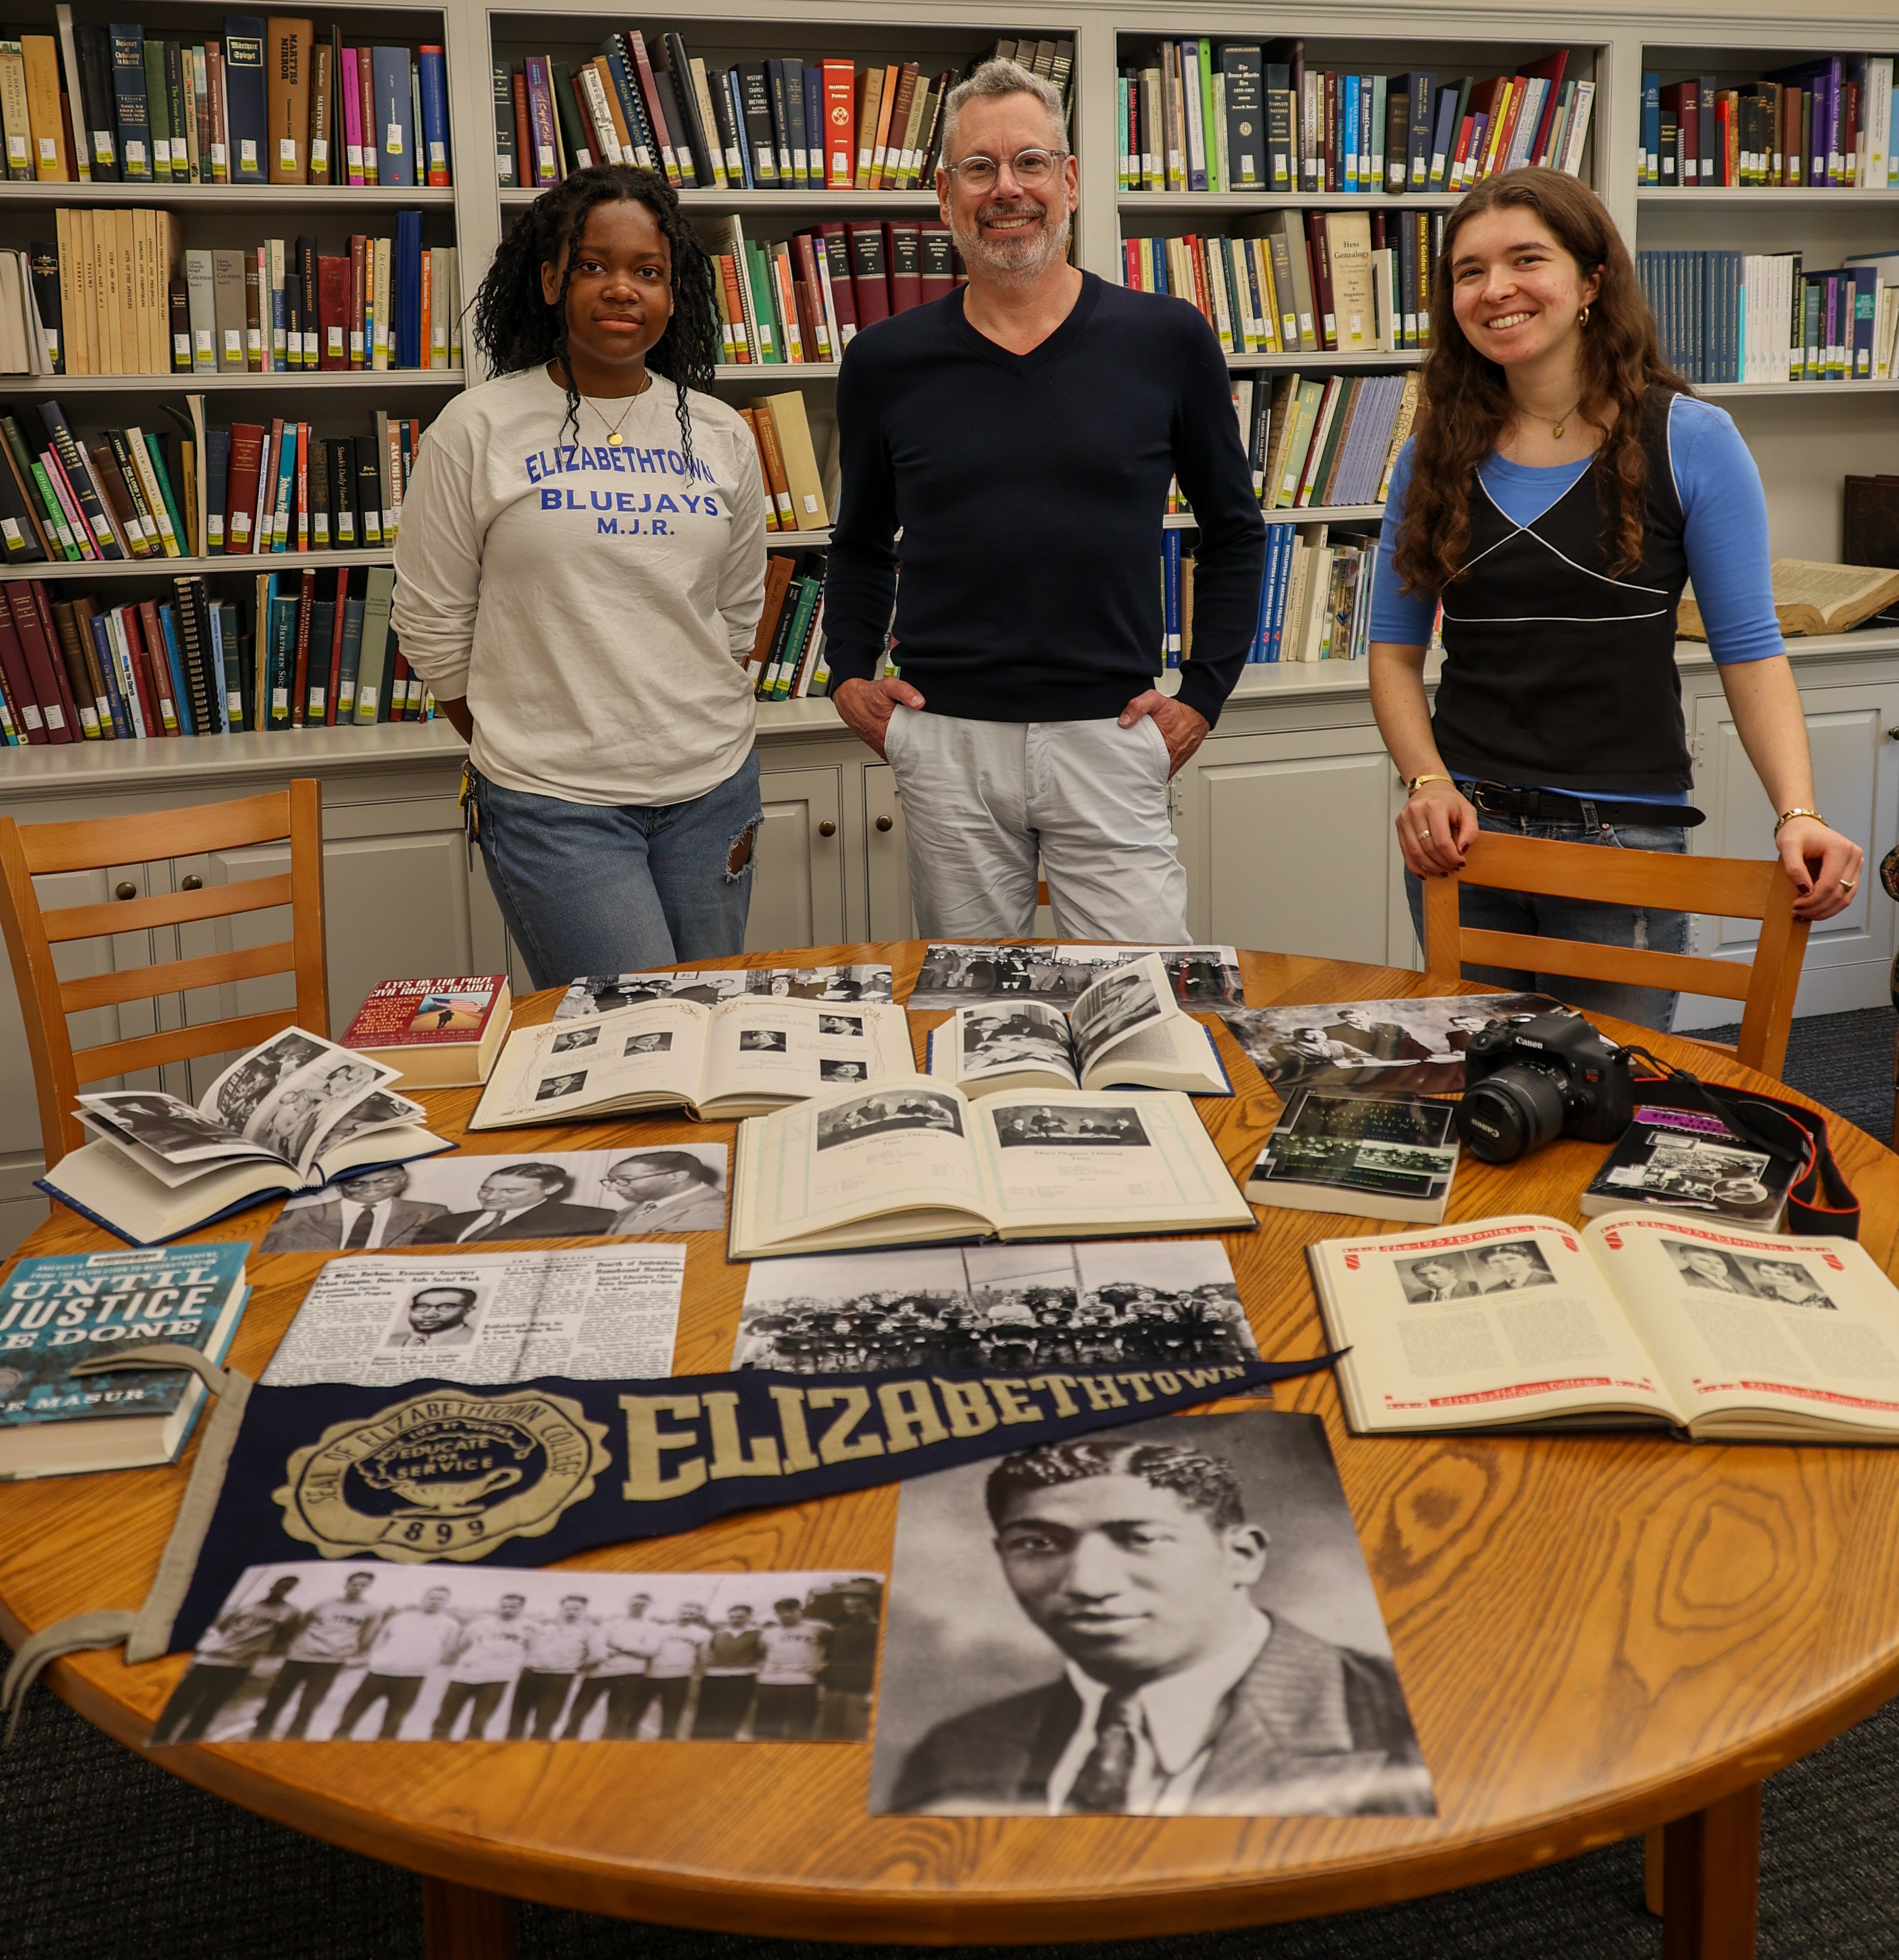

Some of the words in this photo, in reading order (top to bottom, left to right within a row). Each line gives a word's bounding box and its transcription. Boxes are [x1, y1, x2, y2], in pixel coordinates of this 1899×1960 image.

[289, 33, 298, 85] MARTYRS
[6, 66, 15, 118] REFORMATION
[619, 80, 627, 99] FROM
[625, 102, 636, 122] THESE
[632, 124, 642, 145] ROOT
[1523, 95, 1533, 117] LIVING
[1576, 110, 1585, 129] Christ
[1515, 133, 1524, 149] LOVE
[378, 253, 385, 263] De
[275, 290, 283, 329] Postliberals
[1404, 384, 1417, 410] OUR
[1394, 411, 1411, 458] PRESENT
[113, 439, 125, 462] STOFFER
[129, 477, 141, 498] LORD'S
[136, 496, 148, 517] SUPPER
[525, 444, 720, 486] ELIZABETHTOWN
[540, 488, 718, 516] BLUEJAYS
[598, 517, 675, 535] M.J.R.
[1271, 546, 1279, 577] ENCYCLOPEDIA
[1283, 545, 1291, 576] ENCYCLOPEDIA
[1263, 631, 1270, 643] 3
[1274, 630, 1280, 641] 4
[369, 989, 396, 997] CIVIL
[400, 986, 444, 995] RIGHTS
[448, 983, 493, 992] READER
[385, 980, 413, 989] EYES
[1515, 1035, 1543, 1049] Canon
[1471, 1118, 1500, 1137] Canon
[11, 1267, 219, 1300] UNTIL
[0, 1286, 213, 1331] JUSTICE
[0, 1332, 40, 1351] E
[48, 1319, 201, 1346] DONE
[34, 1388, 145, 1410] MASUR
[465, 1423, 515, 1438] VERITAS
[618, 1363, 1247, 1502] ELIZABETHTOWN
[306, 1468, 342, 1506] SEAL
[324, 1448, 355, 1463] OF
[358, 1402, 547, 1448] ELIZABETHTOWN
[540, 1424, 578, 1479] COLLEGE
[400, 1439, 489, 1459] EDUCATE
[428, 1453, 459, 1462] FOR
[396, 1456, 493, 1479] SERVICE
[378, 1520, 486, 1546] 1899
